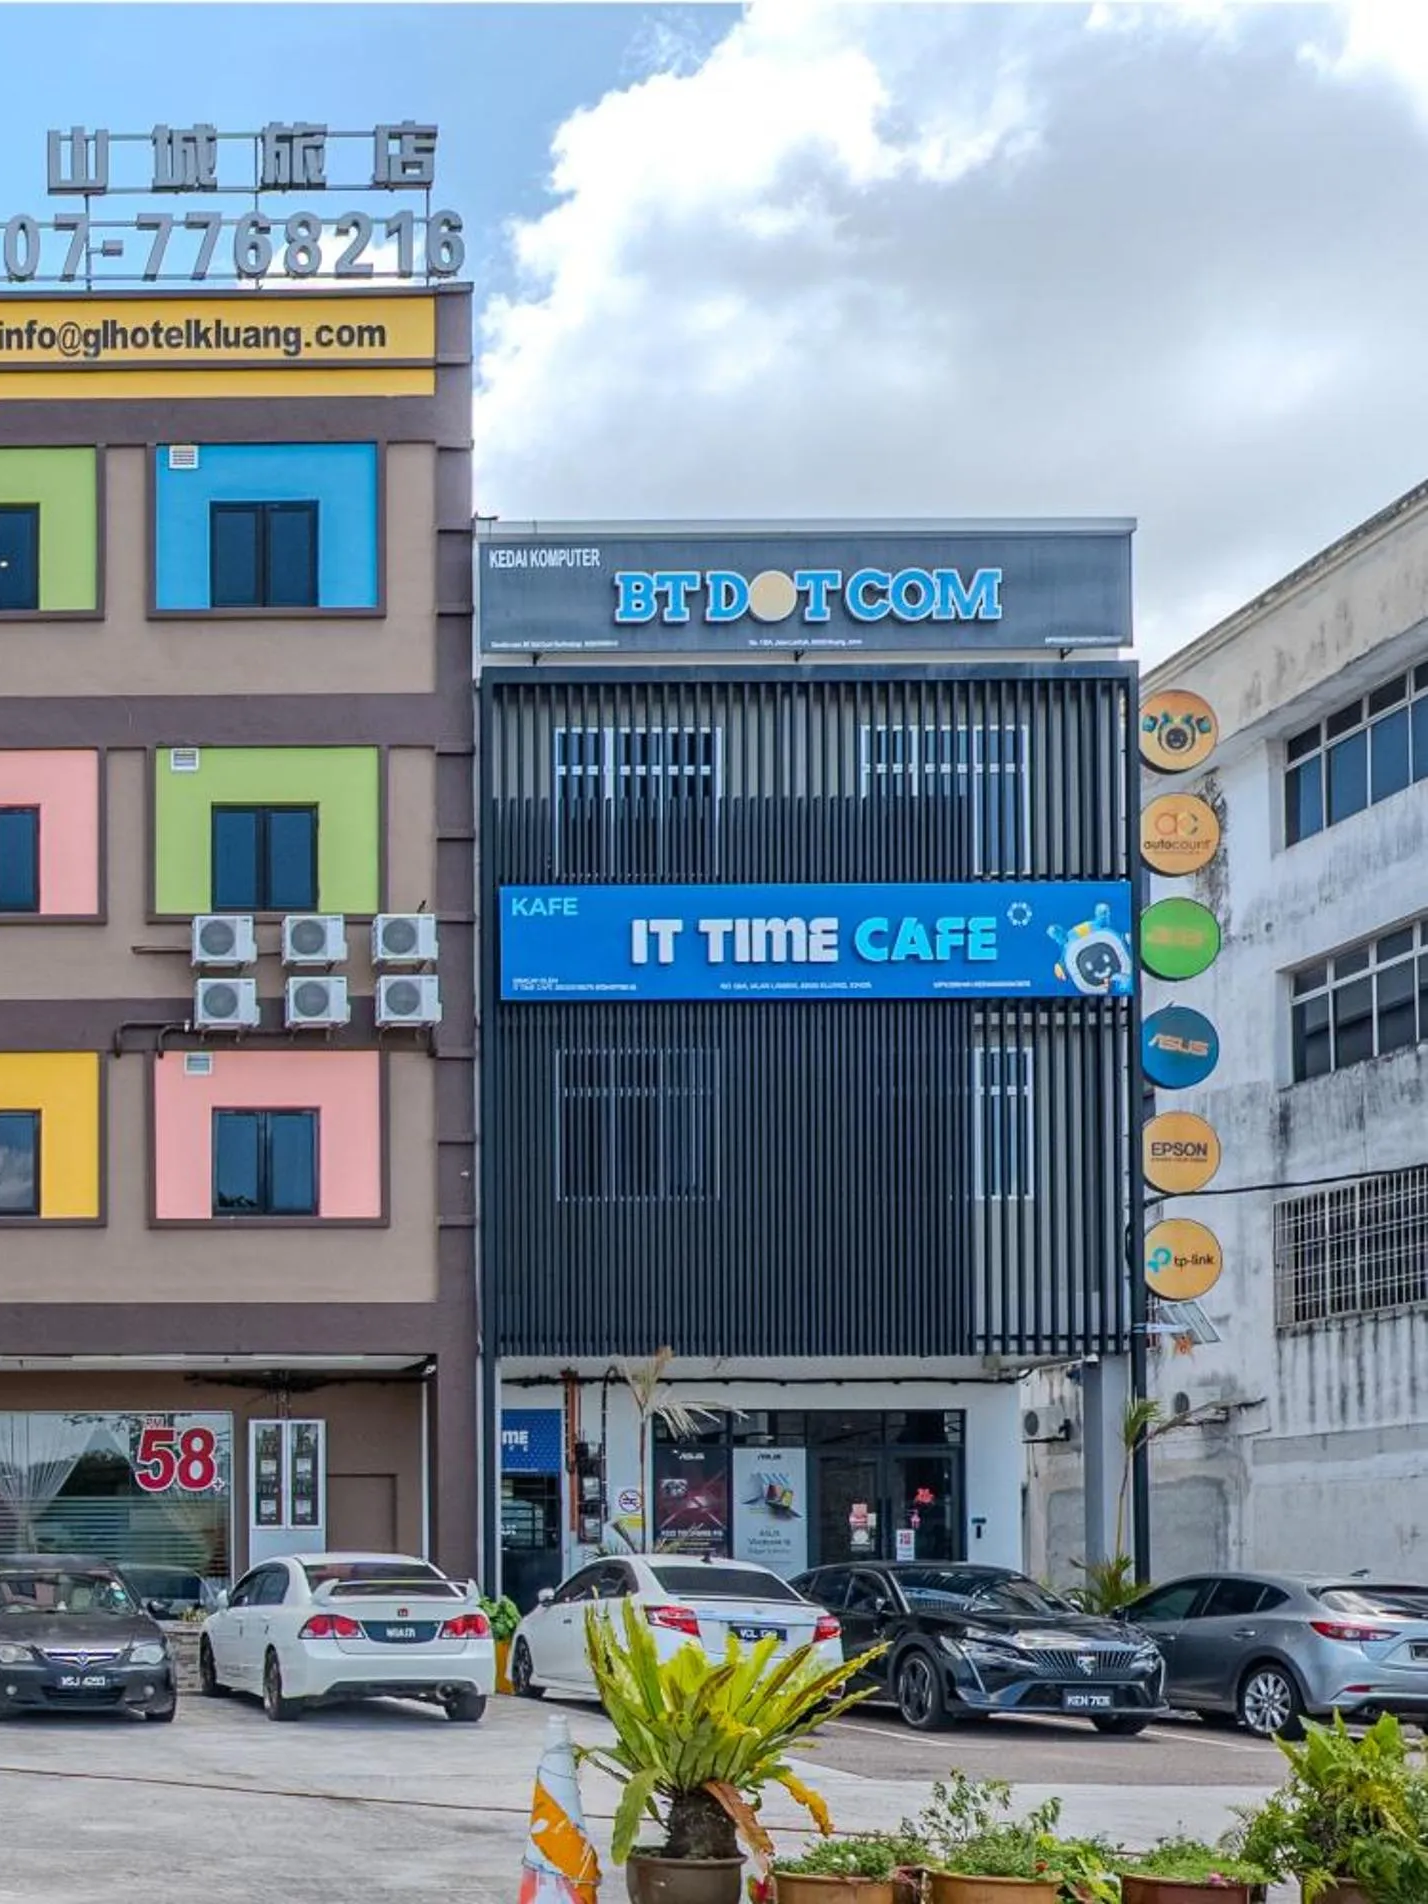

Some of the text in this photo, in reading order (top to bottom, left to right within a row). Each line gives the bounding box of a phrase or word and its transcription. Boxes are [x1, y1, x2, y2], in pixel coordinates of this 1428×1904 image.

[47, 120, 438, 195] 山城旅店
[489, 548, 601, 568] KEDAI KOMPUTER
[511, 897, 579, 917] KAFE
[631, 919, 684, 964] IT
[855, 917, 998, 962] CAFE
[1151, 1142, 1209, 1157] EPSON
[1174, 1253, 1216, 1271] tp-link
